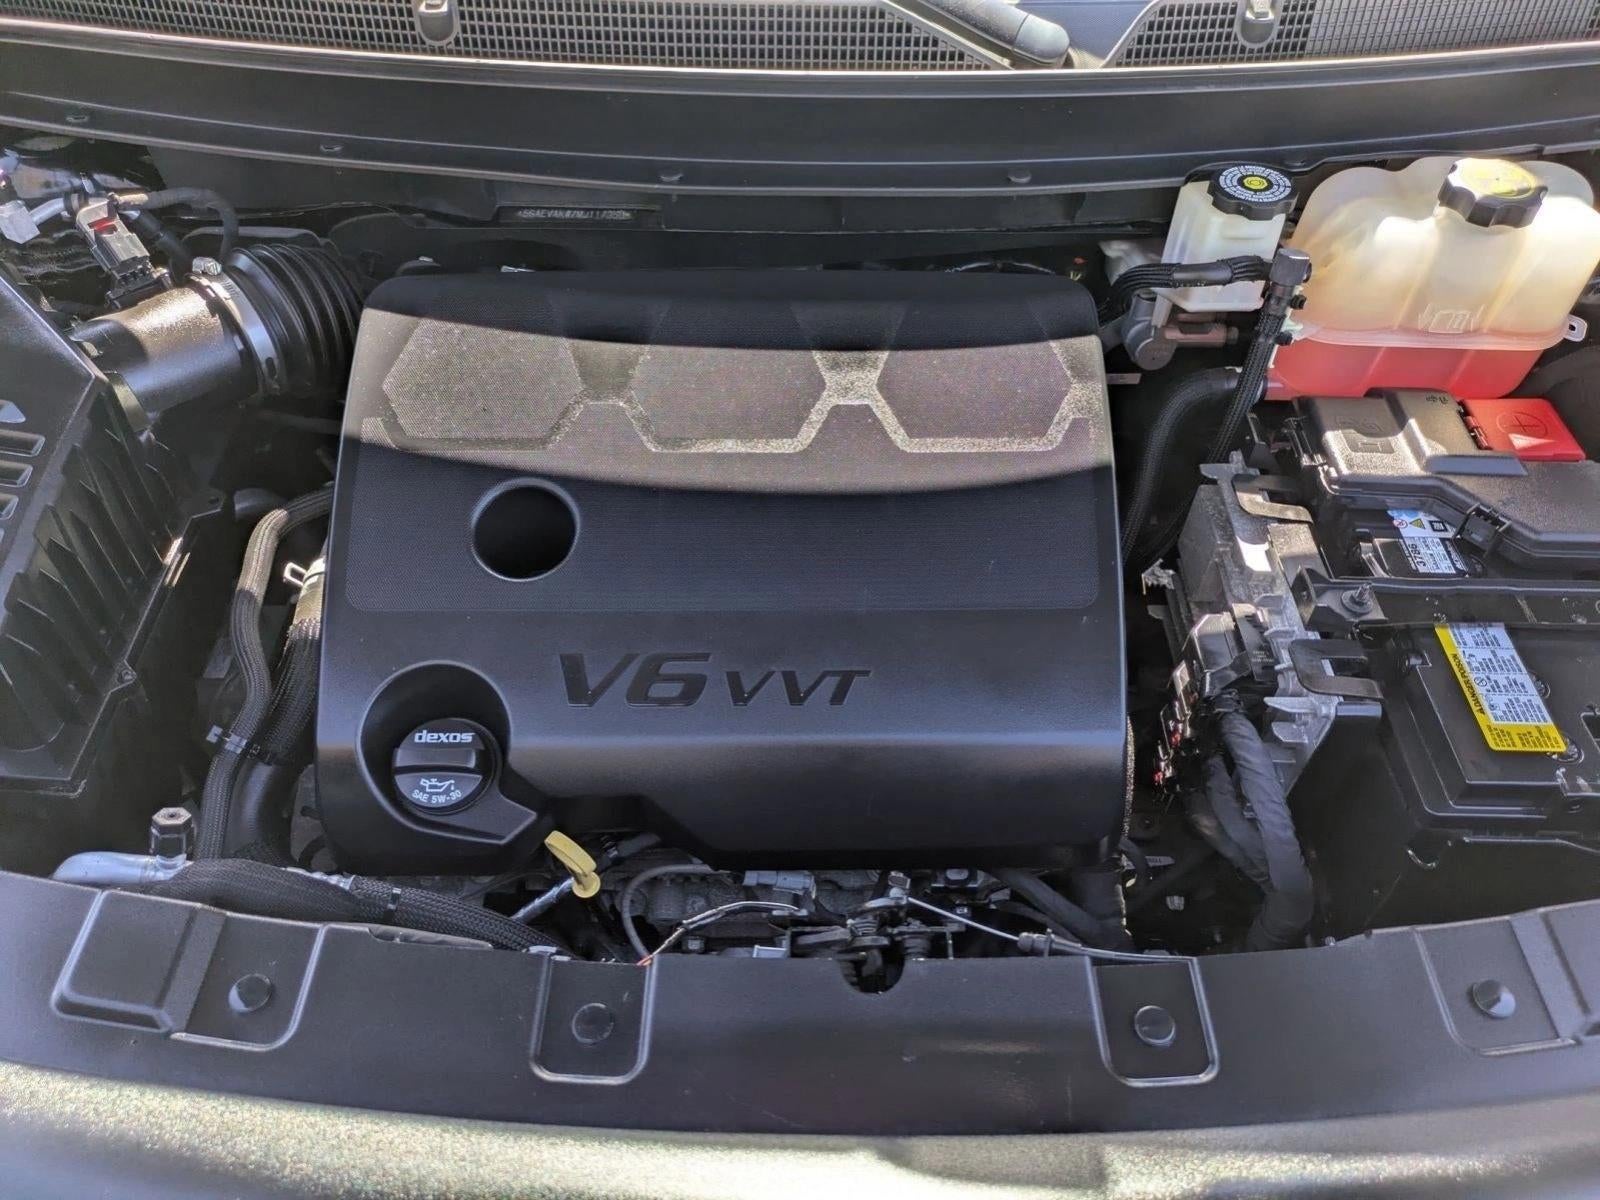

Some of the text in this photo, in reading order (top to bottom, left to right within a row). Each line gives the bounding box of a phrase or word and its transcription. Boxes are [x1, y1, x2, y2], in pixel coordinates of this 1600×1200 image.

[559, 652, 872, 708] V6 VVT
[414, 729, 476, 743] dexos
[412, 789, 462, 804] SAE 5W-30
